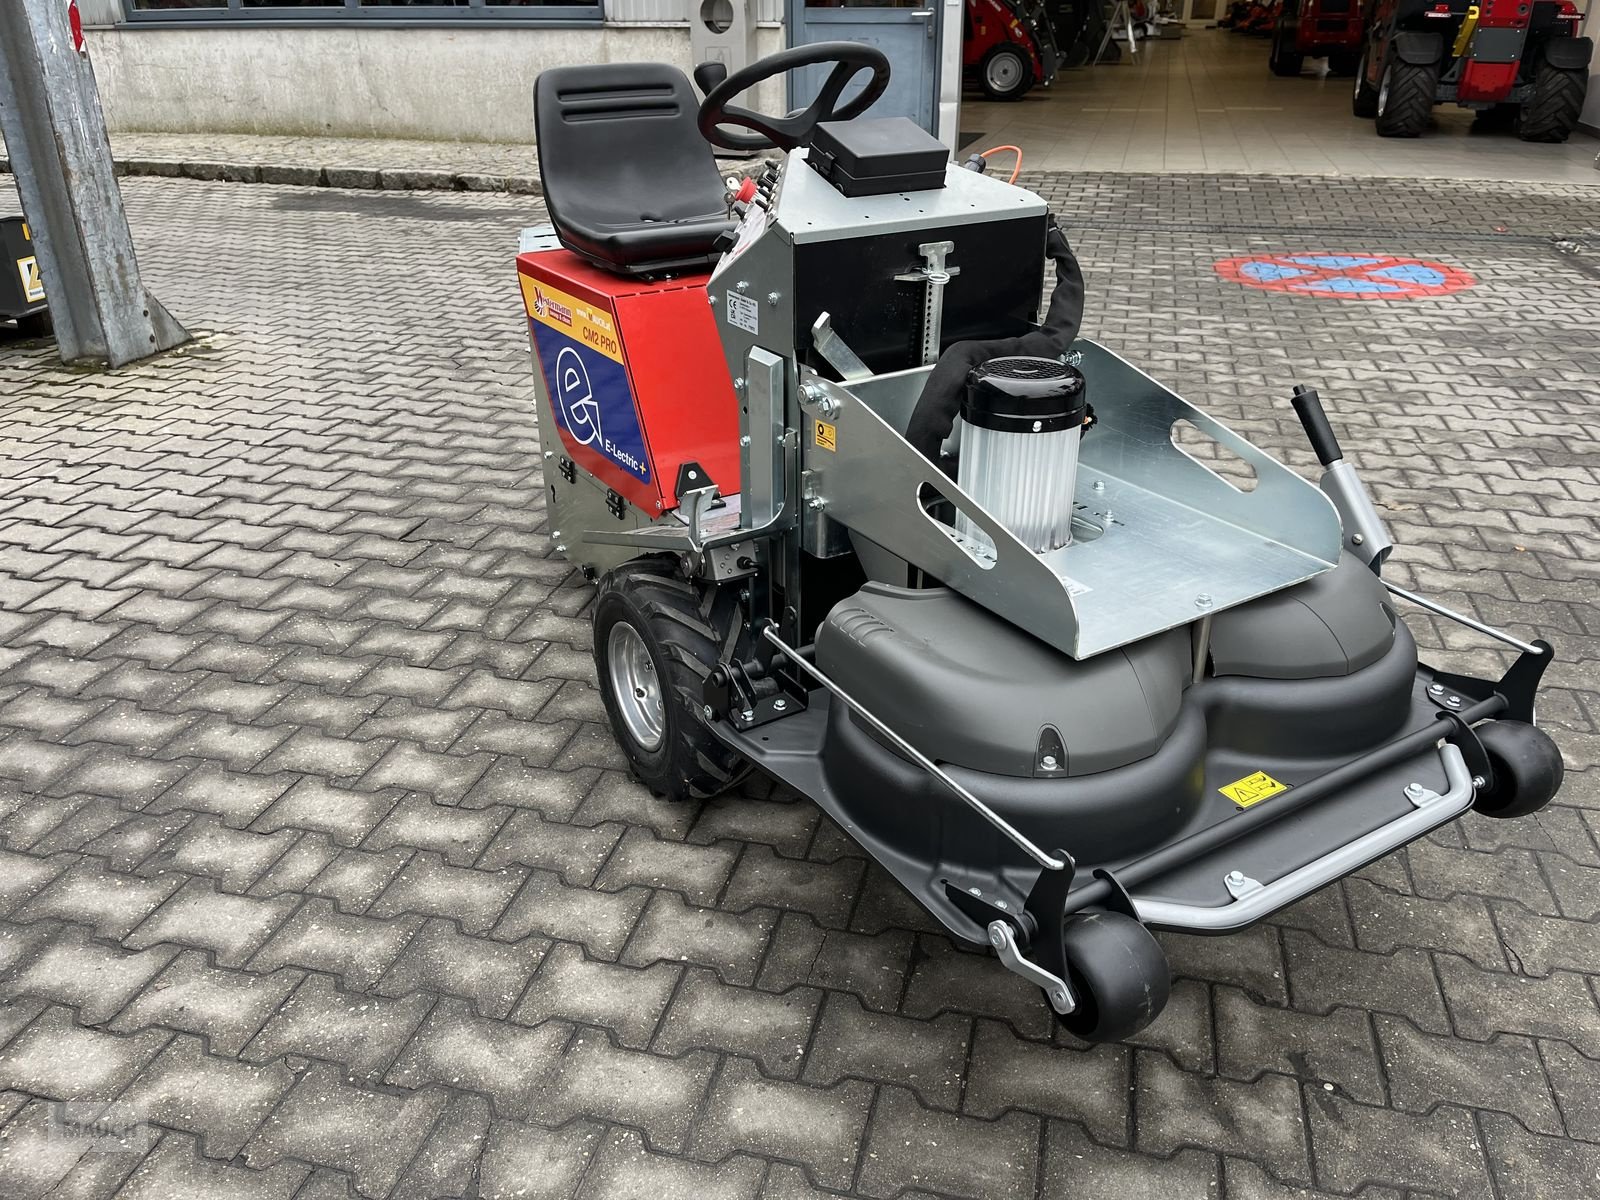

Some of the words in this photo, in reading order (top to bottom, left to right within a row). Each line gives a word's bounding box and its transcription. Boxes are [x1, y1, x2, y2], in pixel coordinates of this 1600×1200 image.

[582, 326, 600, 345] CM2
[600, 335, 617, 355] PRO
[605, 439, 638, 471] E-Lectric
